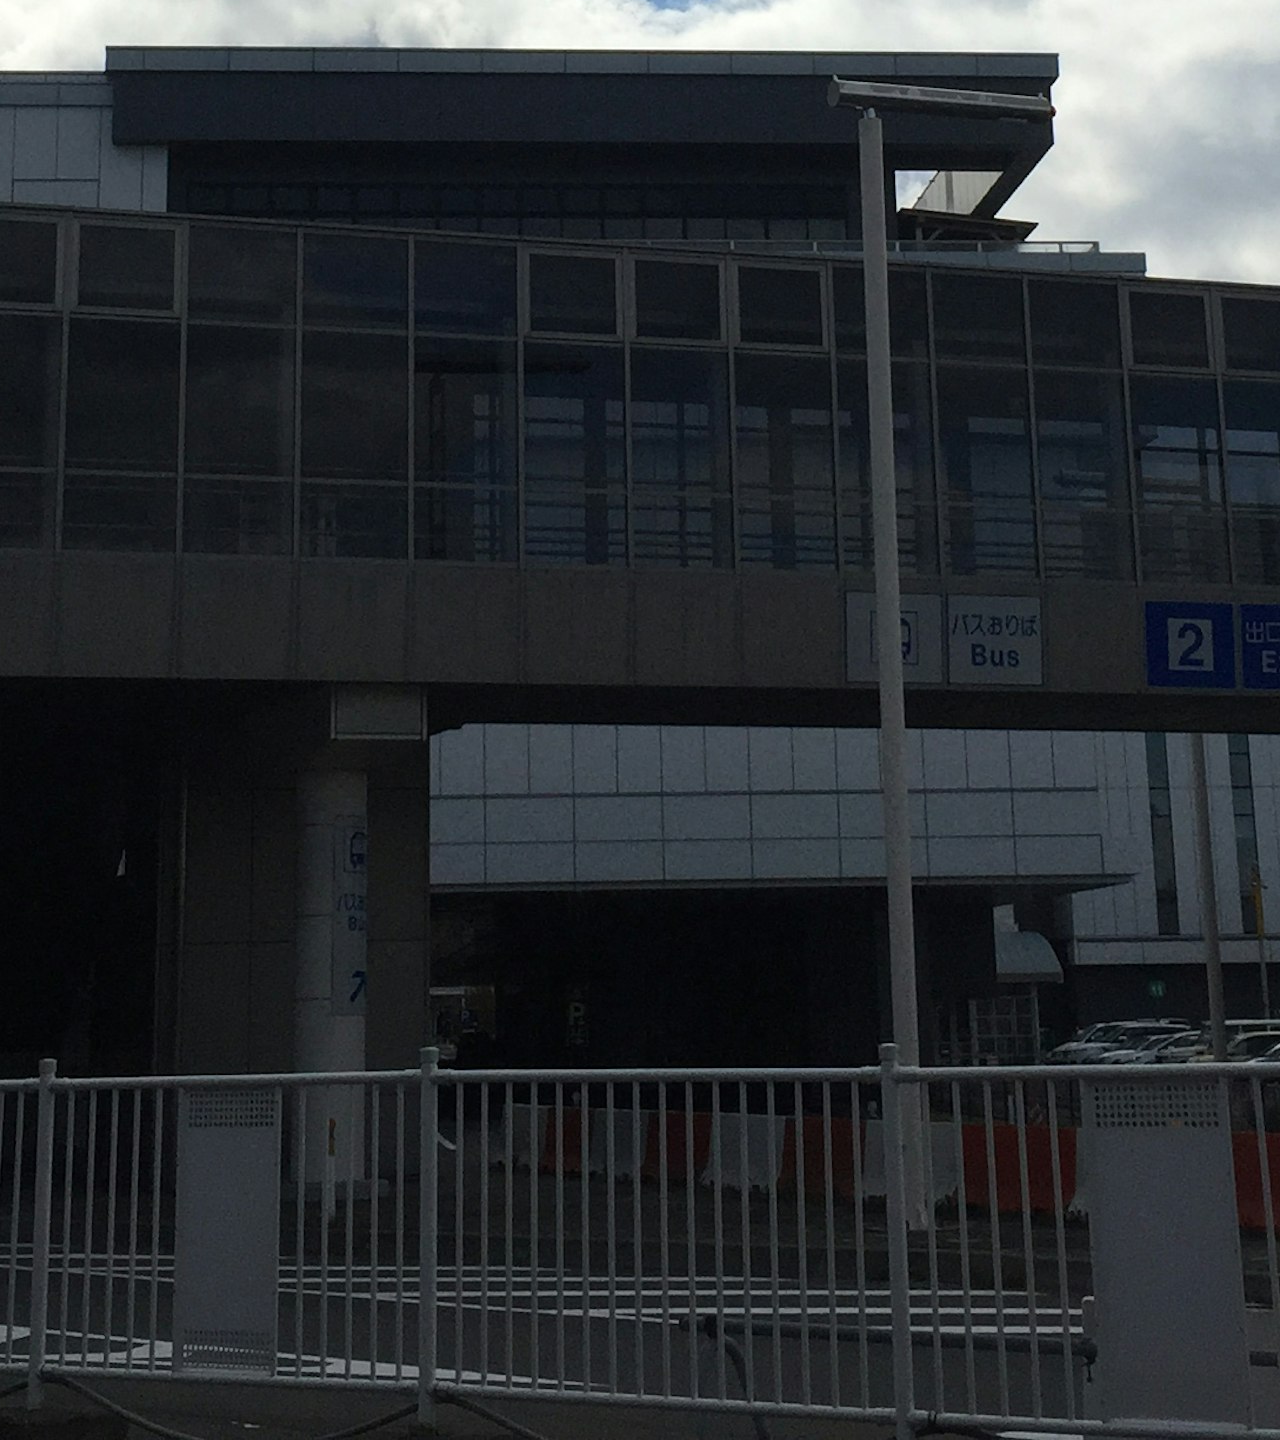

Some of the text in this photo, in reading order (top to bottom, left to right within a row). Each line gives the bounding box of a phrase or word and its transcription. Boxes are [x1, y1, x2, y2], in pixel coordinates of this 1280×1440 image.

[951, 613, 1038, 637] バスおりば
[970, 643, 1020, 667] Bus
[1177, 622, 1205, 667] 2
